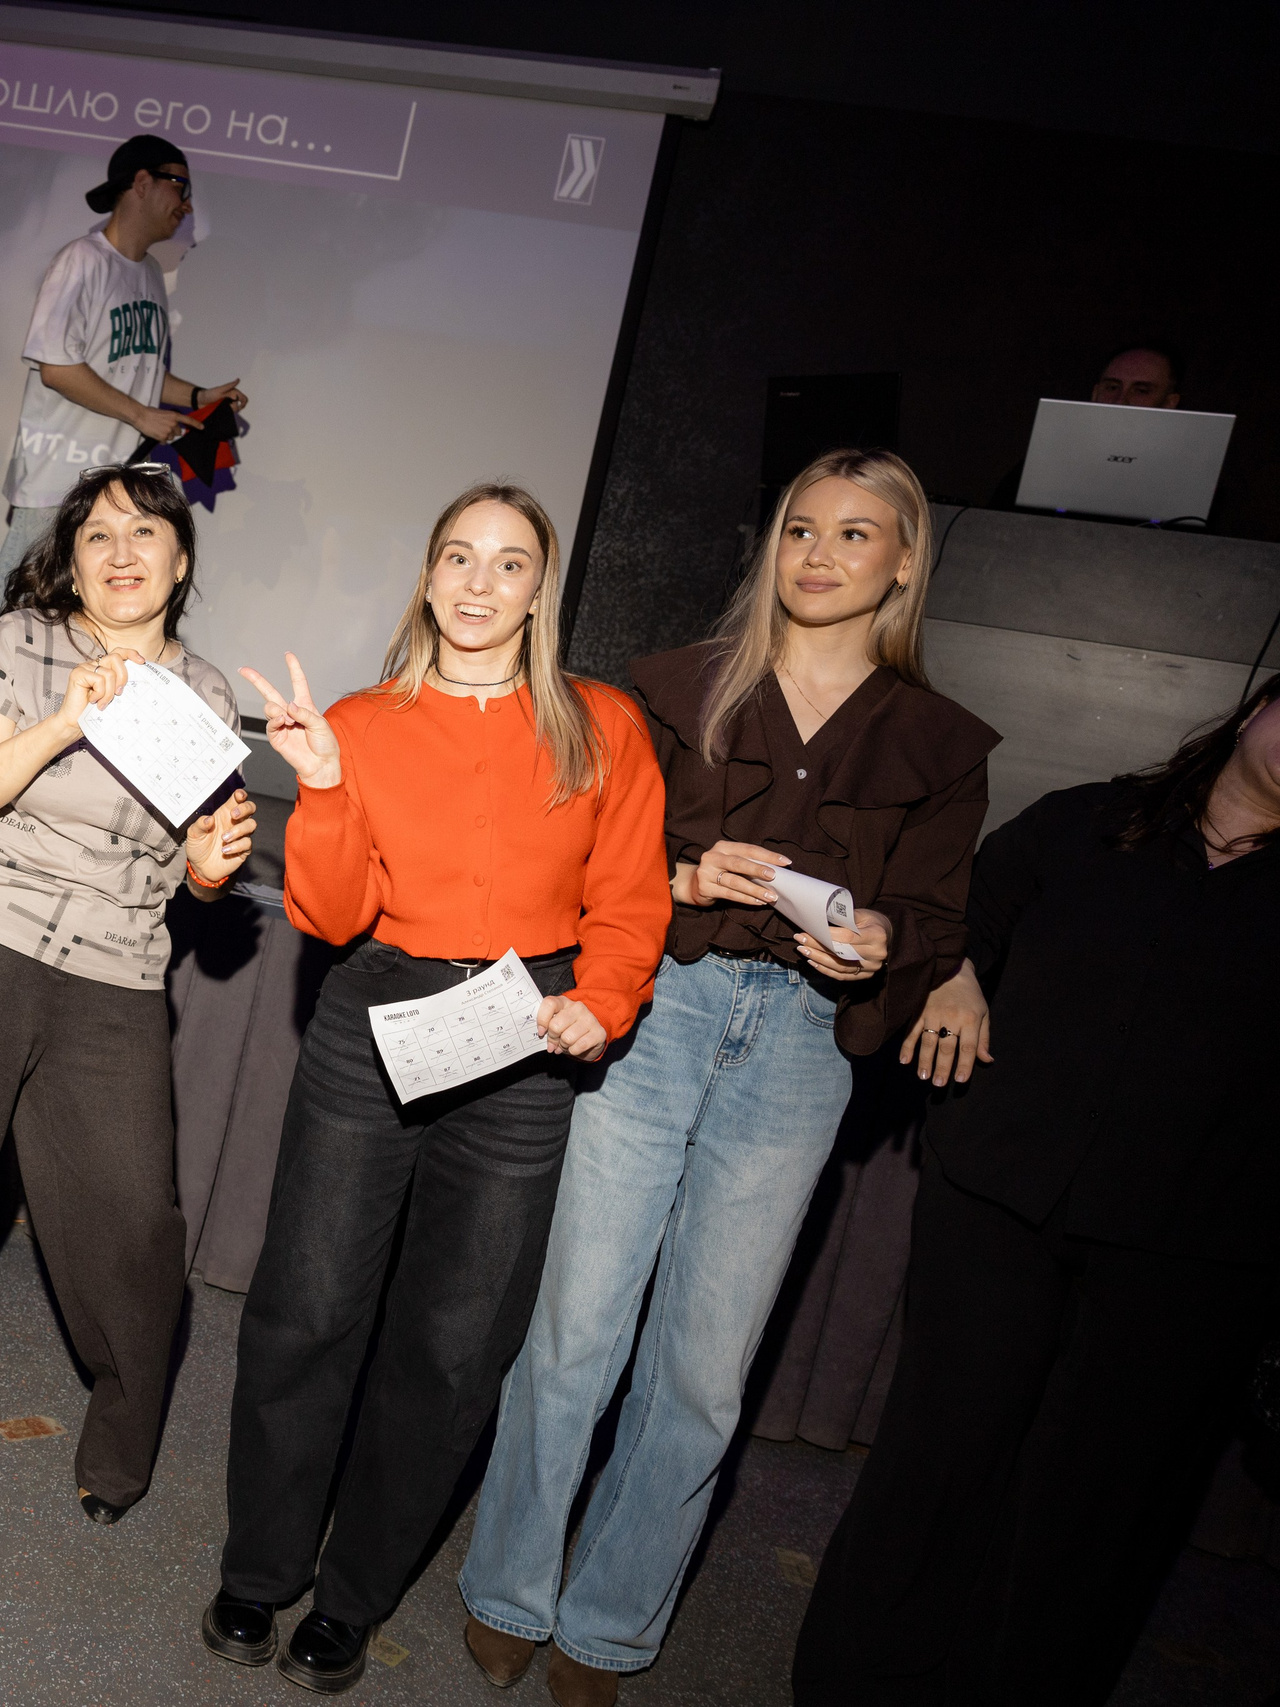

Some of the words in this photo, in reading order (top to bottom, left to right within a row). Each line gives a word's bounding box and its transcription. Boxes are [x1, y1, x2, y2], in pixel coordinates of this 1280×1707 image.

[134, 98, 212, 135] его
[227, 109, 332, 153] на...
[145, 662, 161, 676] ARAOKE
[200, 716, 218, 735] раунд
[104, 931, 137, 947] DEARAR
[472, 979, 496, 994] раунд
[383, 1011, 406, 1021] KARAOKE
[406, 1009, 420, 1017] LOTO
